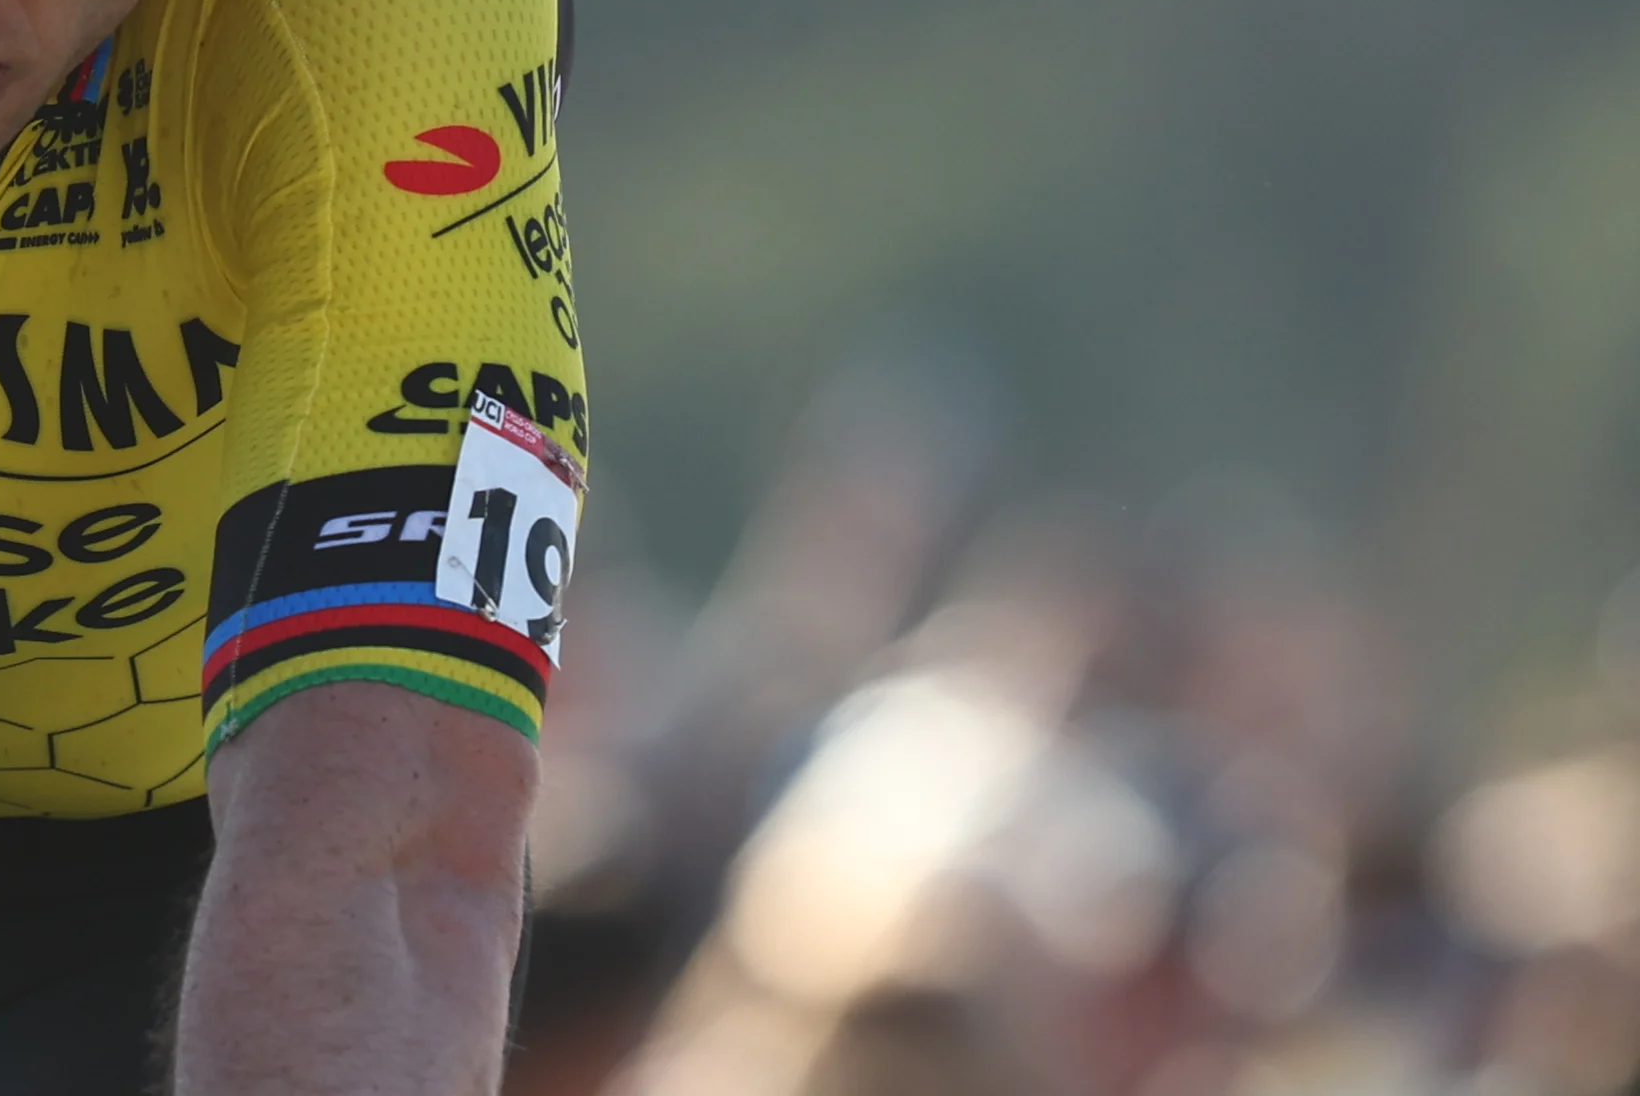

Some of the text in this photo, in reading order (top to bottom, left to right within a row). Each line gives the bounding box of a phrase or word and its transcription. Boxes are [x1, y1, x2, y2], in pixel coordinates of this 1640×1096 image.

[1, 182, 96, 231] CAP
[473, 392, 504, 424] UCI
[468, 488, 572, 646] 19
